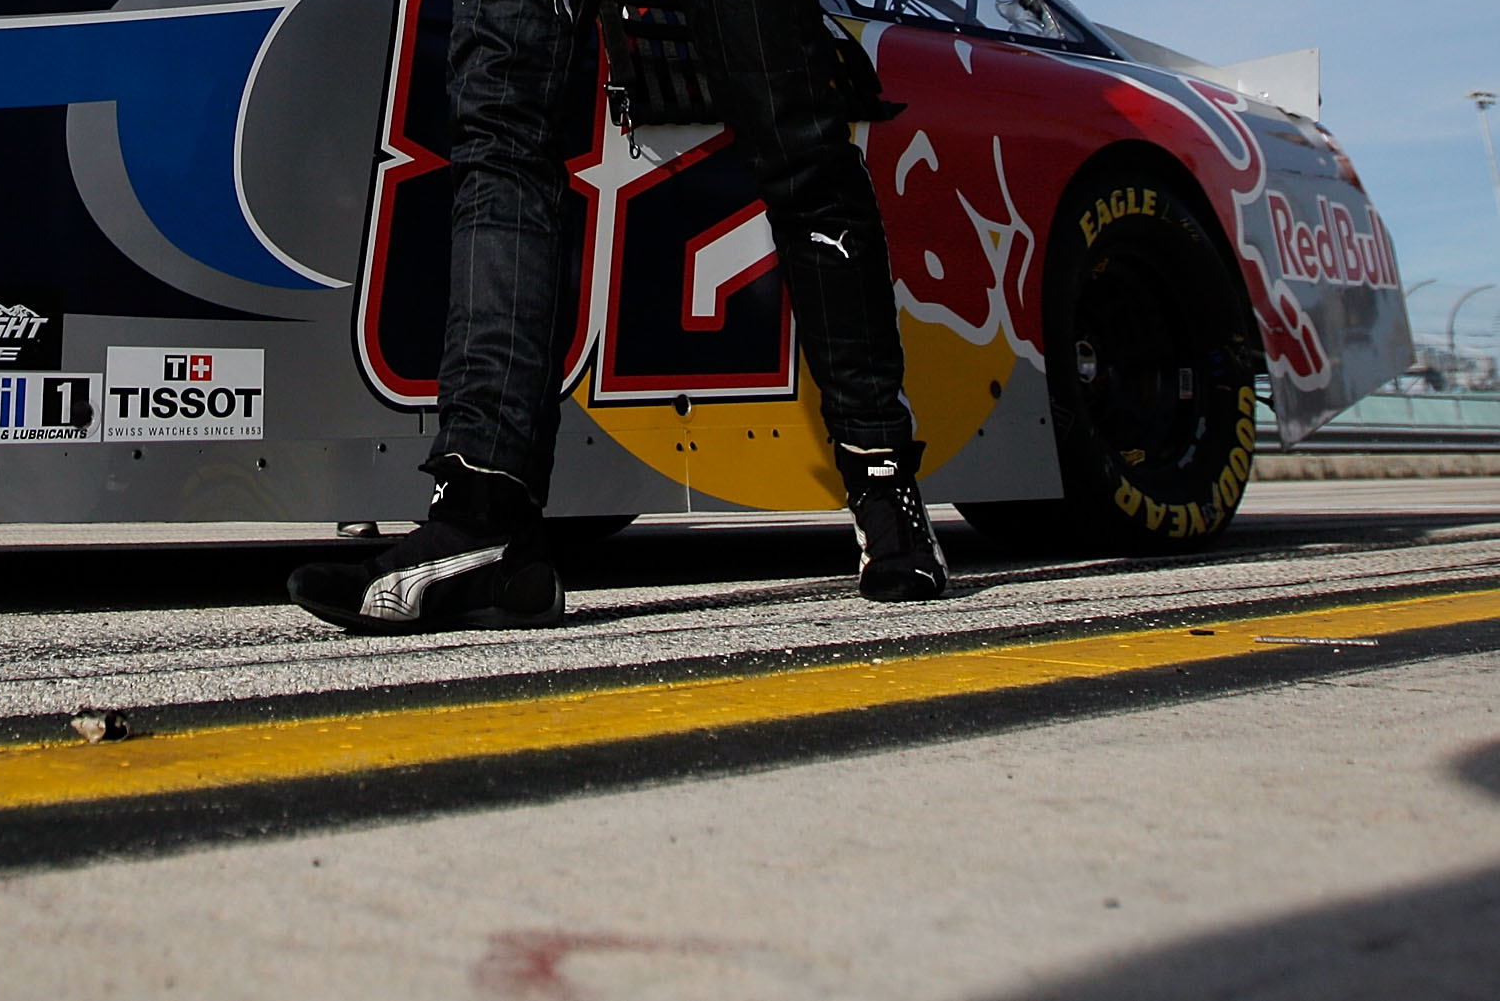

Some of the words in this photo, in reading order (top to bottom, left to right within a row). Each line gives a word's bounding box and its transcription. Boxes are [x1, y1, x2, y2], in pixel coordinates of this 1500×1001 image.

[1079, 186, 1158, 249] EAGLE
[1266, 189, 1341, 284] Red
[1331, 202, 1400, 290] Bull
[109, 387, 262, 420] TISSOT
[0, 430, 9, 440] &
[13, 428, 88, 440] LUBRICANTS
[107, 427, 143, 437] SWISS
[148, 426, 199, 436] WATCHES
[203, 426, 235, 436] SINCE
[240, 426, 262, 435] 1853
